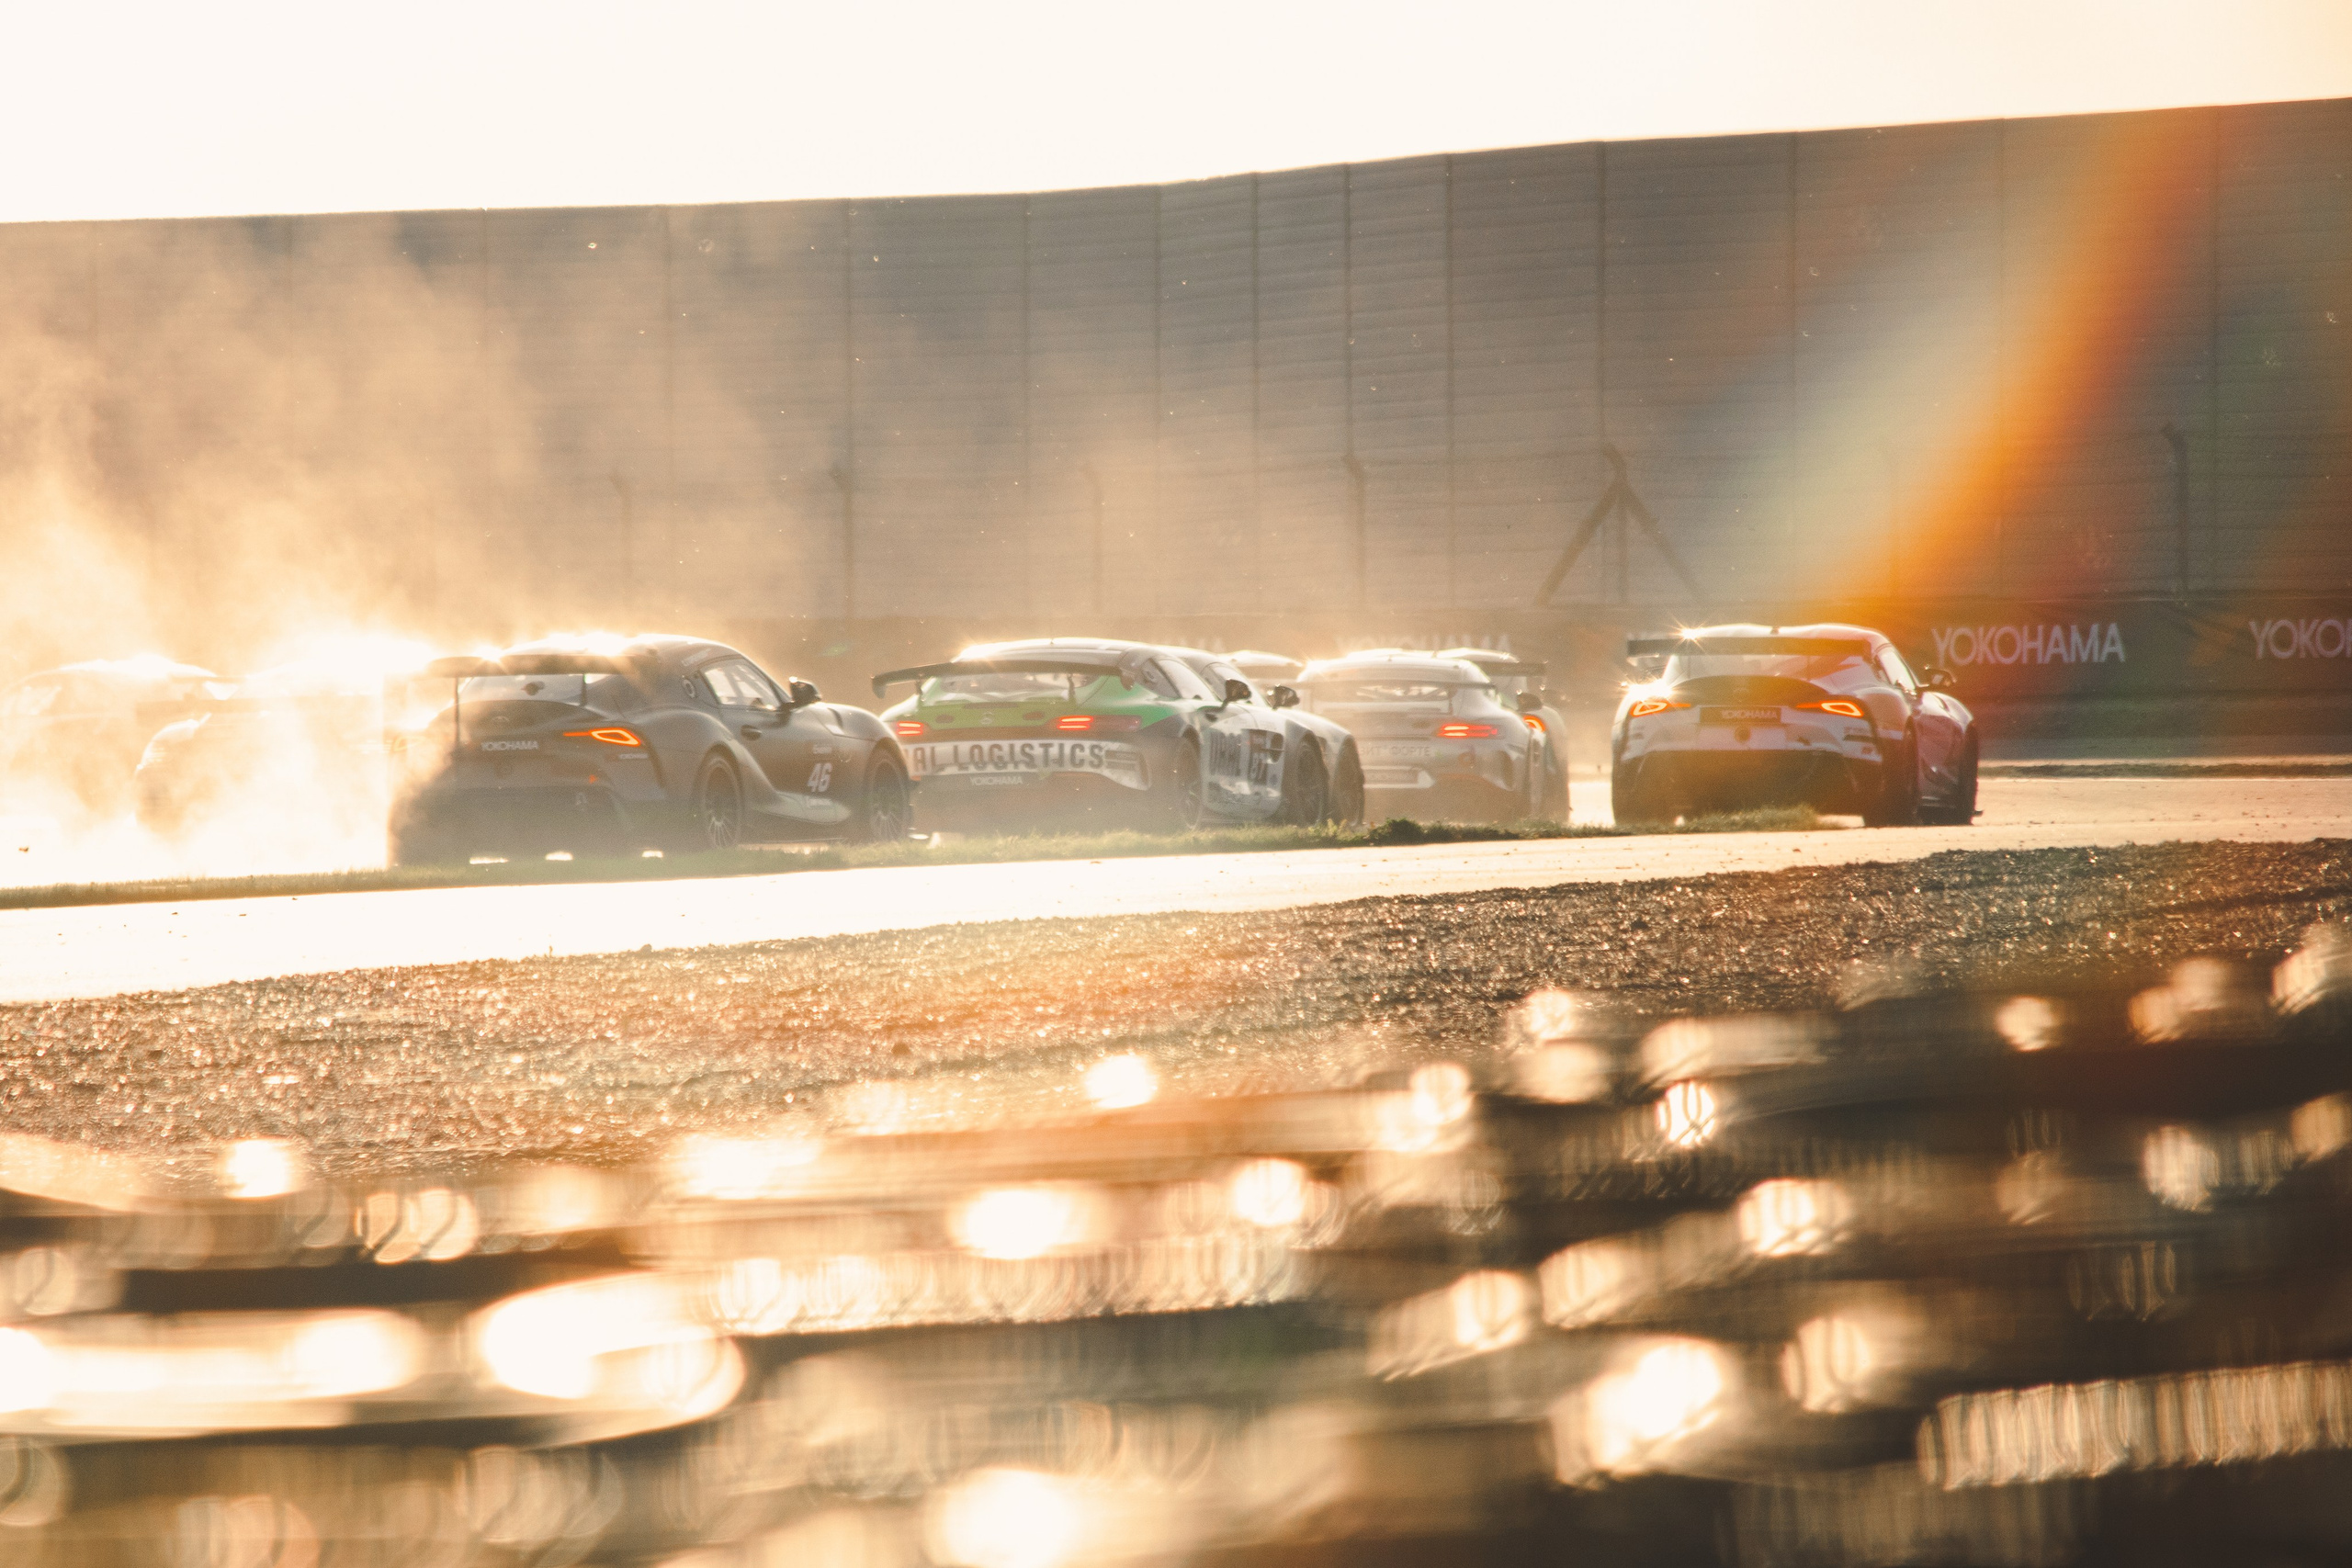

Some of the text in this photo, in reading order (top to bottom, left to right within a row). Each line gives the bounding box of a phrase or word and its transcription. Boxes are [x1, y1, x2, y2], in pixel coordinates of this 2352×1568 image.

[1931, 623, 2126, 668] YOKOHAMA
[481, 740, 538, 751] YOKOHAMA
[953, 742, 1104, 771] LOGISTICS
[807, 762, 833, 792] 46
[969, 775, 1023, 787] YOKOHAMA
